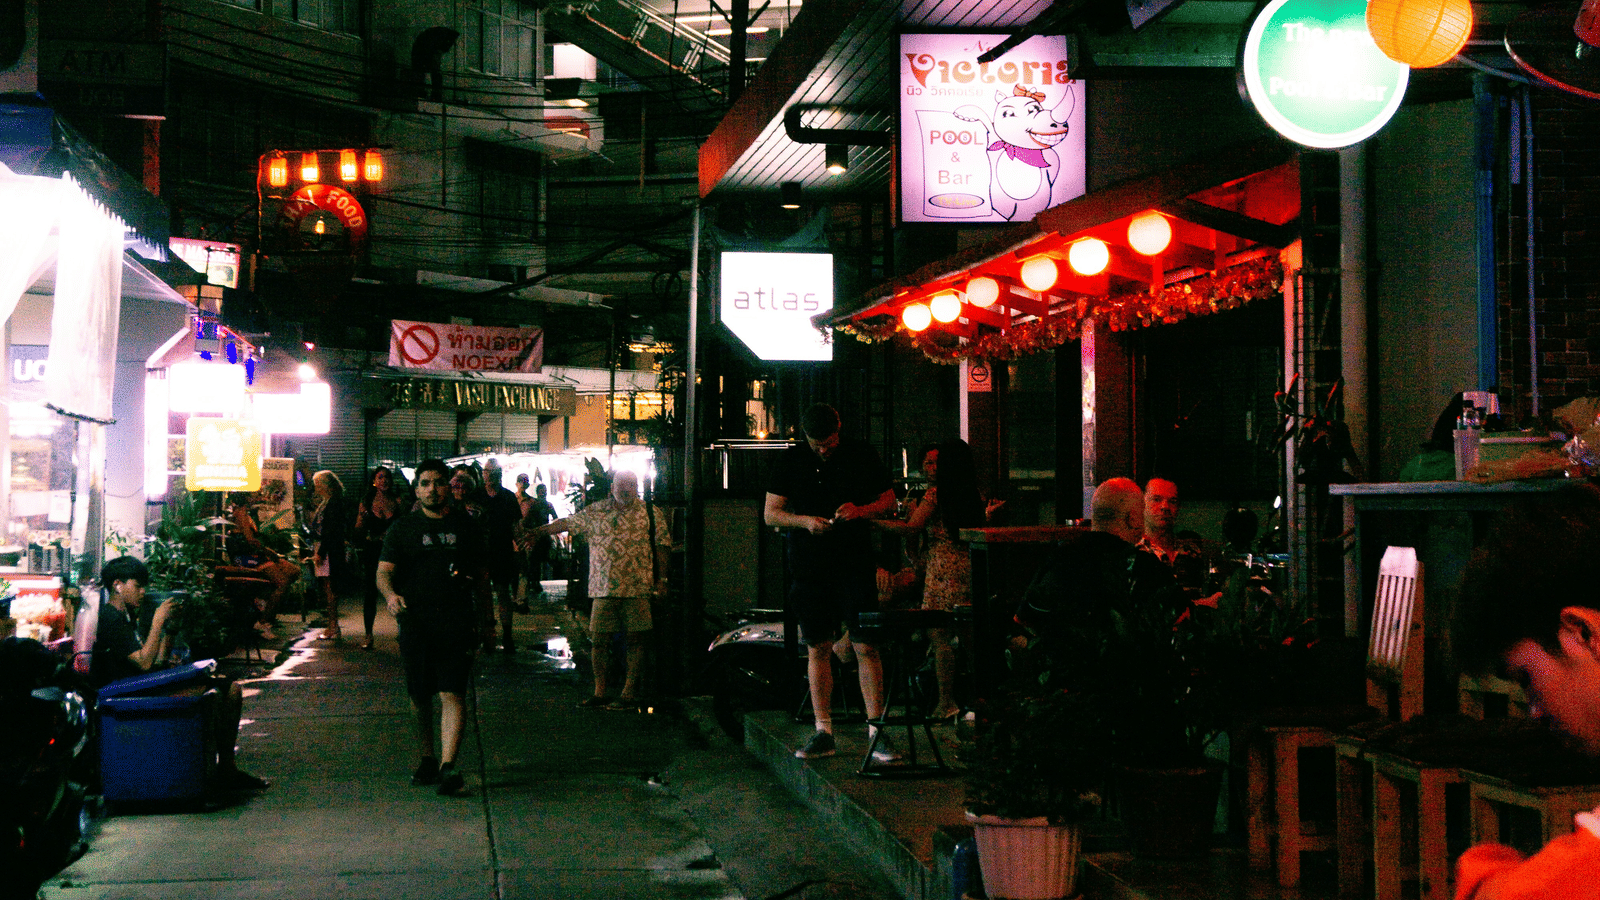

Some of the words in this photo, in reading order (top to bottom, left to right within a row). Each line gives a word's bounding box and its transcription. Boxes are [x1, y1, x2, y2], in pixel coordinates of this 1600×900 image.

[1283, 22, 1325, 45] The
[59, 49, 126, 72] ATM
[905, 53, 1076, 88] Victoria
[1269, 76, 1317, 98] Pool
[1347, 82, 1388, 102] Bar
[930, 130, 984, 145] POOL
[950, 151, 961, 163] &
[938, 170, 973, 185] Bar
[326, 189, 363, 227] FOOD
[734, 287, 819, 311] atlas
[447, 325, 533, 351] ห้ามออก
[13, 358, 49, 381] UO
[454, 381, 490, 406] VASU
[494, 384, 561, 411] EXCHANGE
